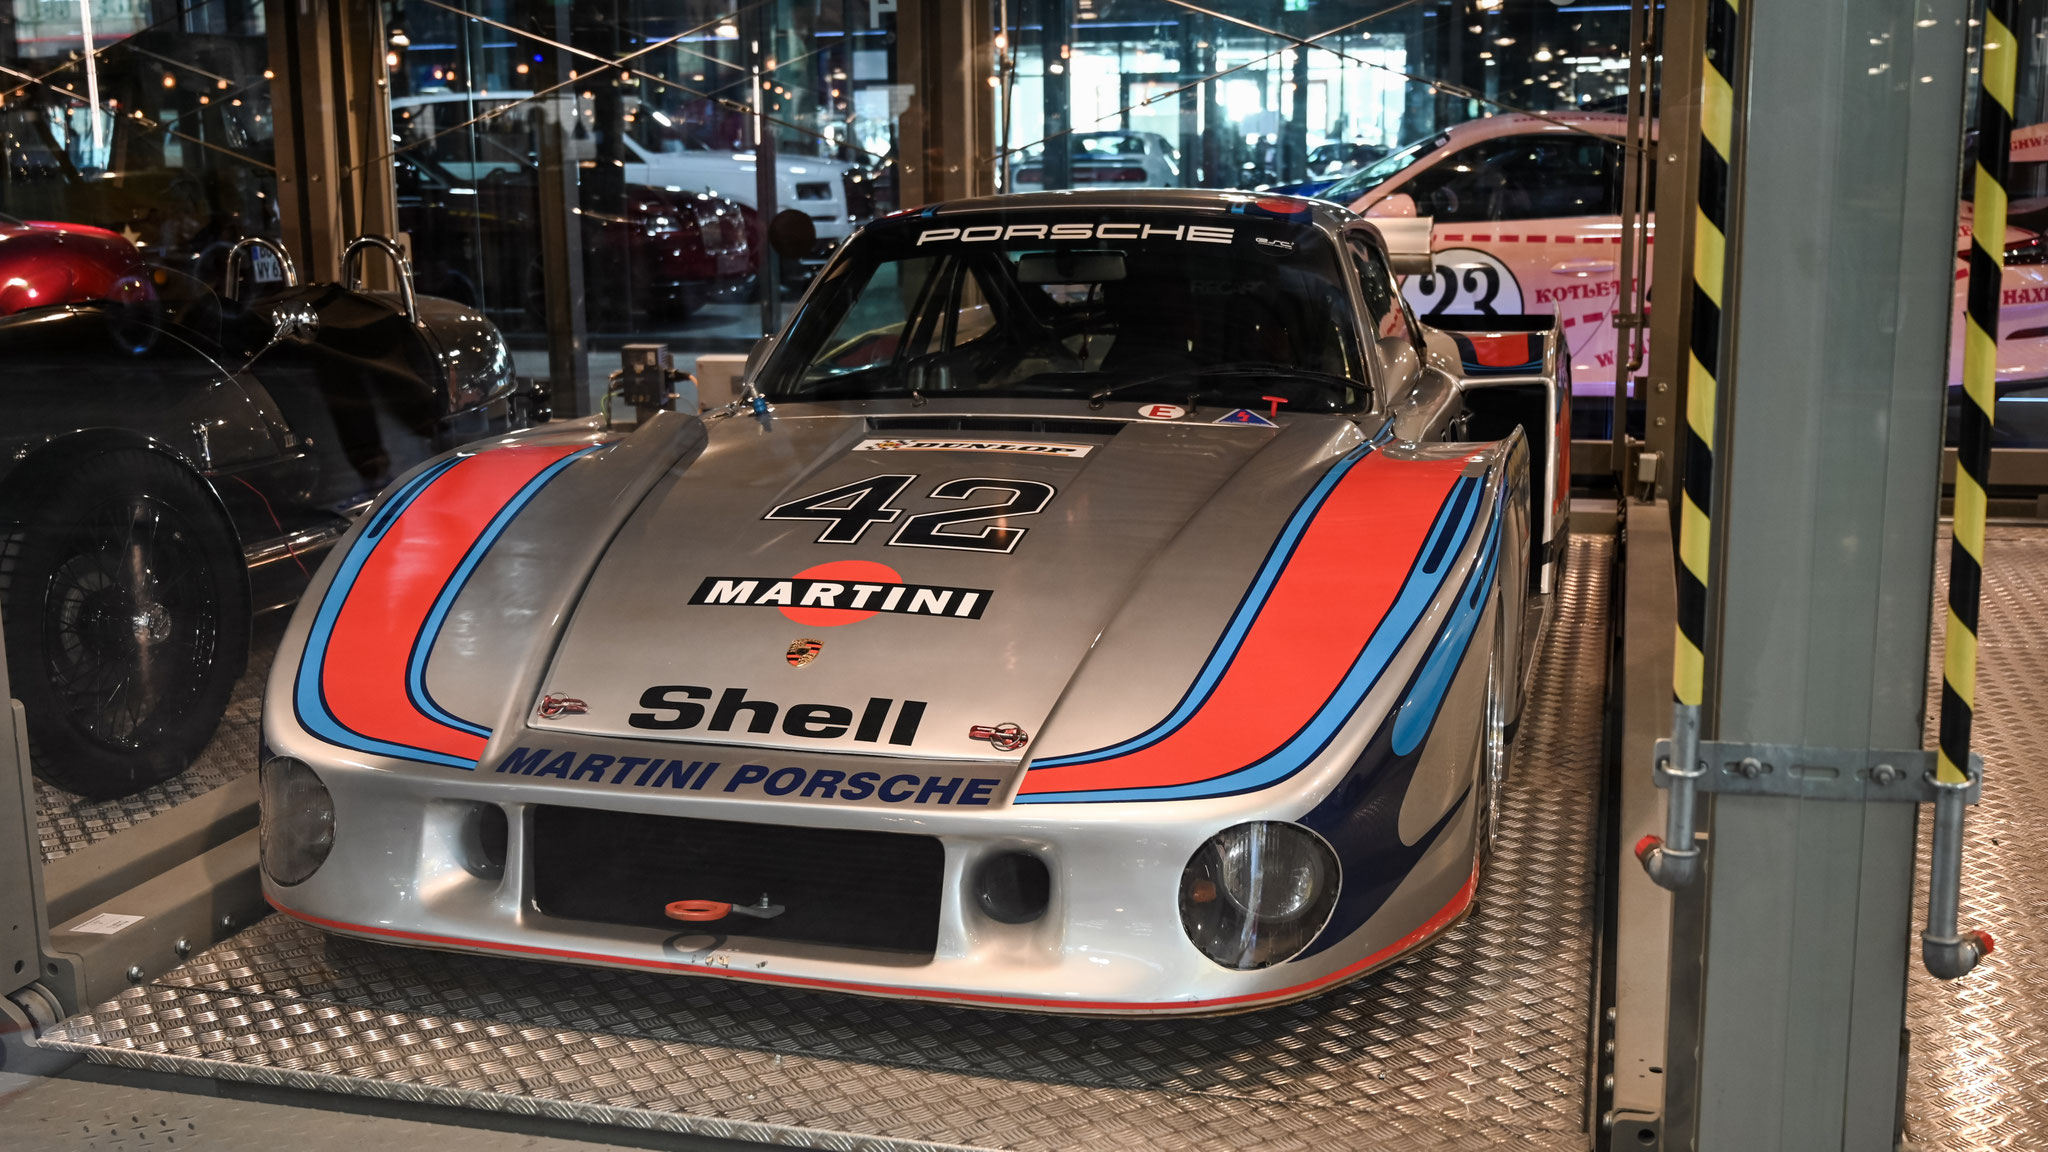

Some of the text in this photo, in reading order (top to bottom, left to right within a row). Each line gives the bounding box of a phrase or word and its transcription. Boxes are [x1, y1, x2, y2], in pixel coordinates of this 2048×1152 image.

[916, 223, 1235, 246] PORSCHE
[1418, 262, 1501, 315] 23
[1147, 404, 1176, 419] E
[911, 442, 1077, 454] DUNLOP
[760, 473, 1058, 555] 42
[705, 579, 981, 617] MARTINI
[628, 685, 928, 746] Shell
[496, 747, 1002, 806] MARTINI PORSCHE
